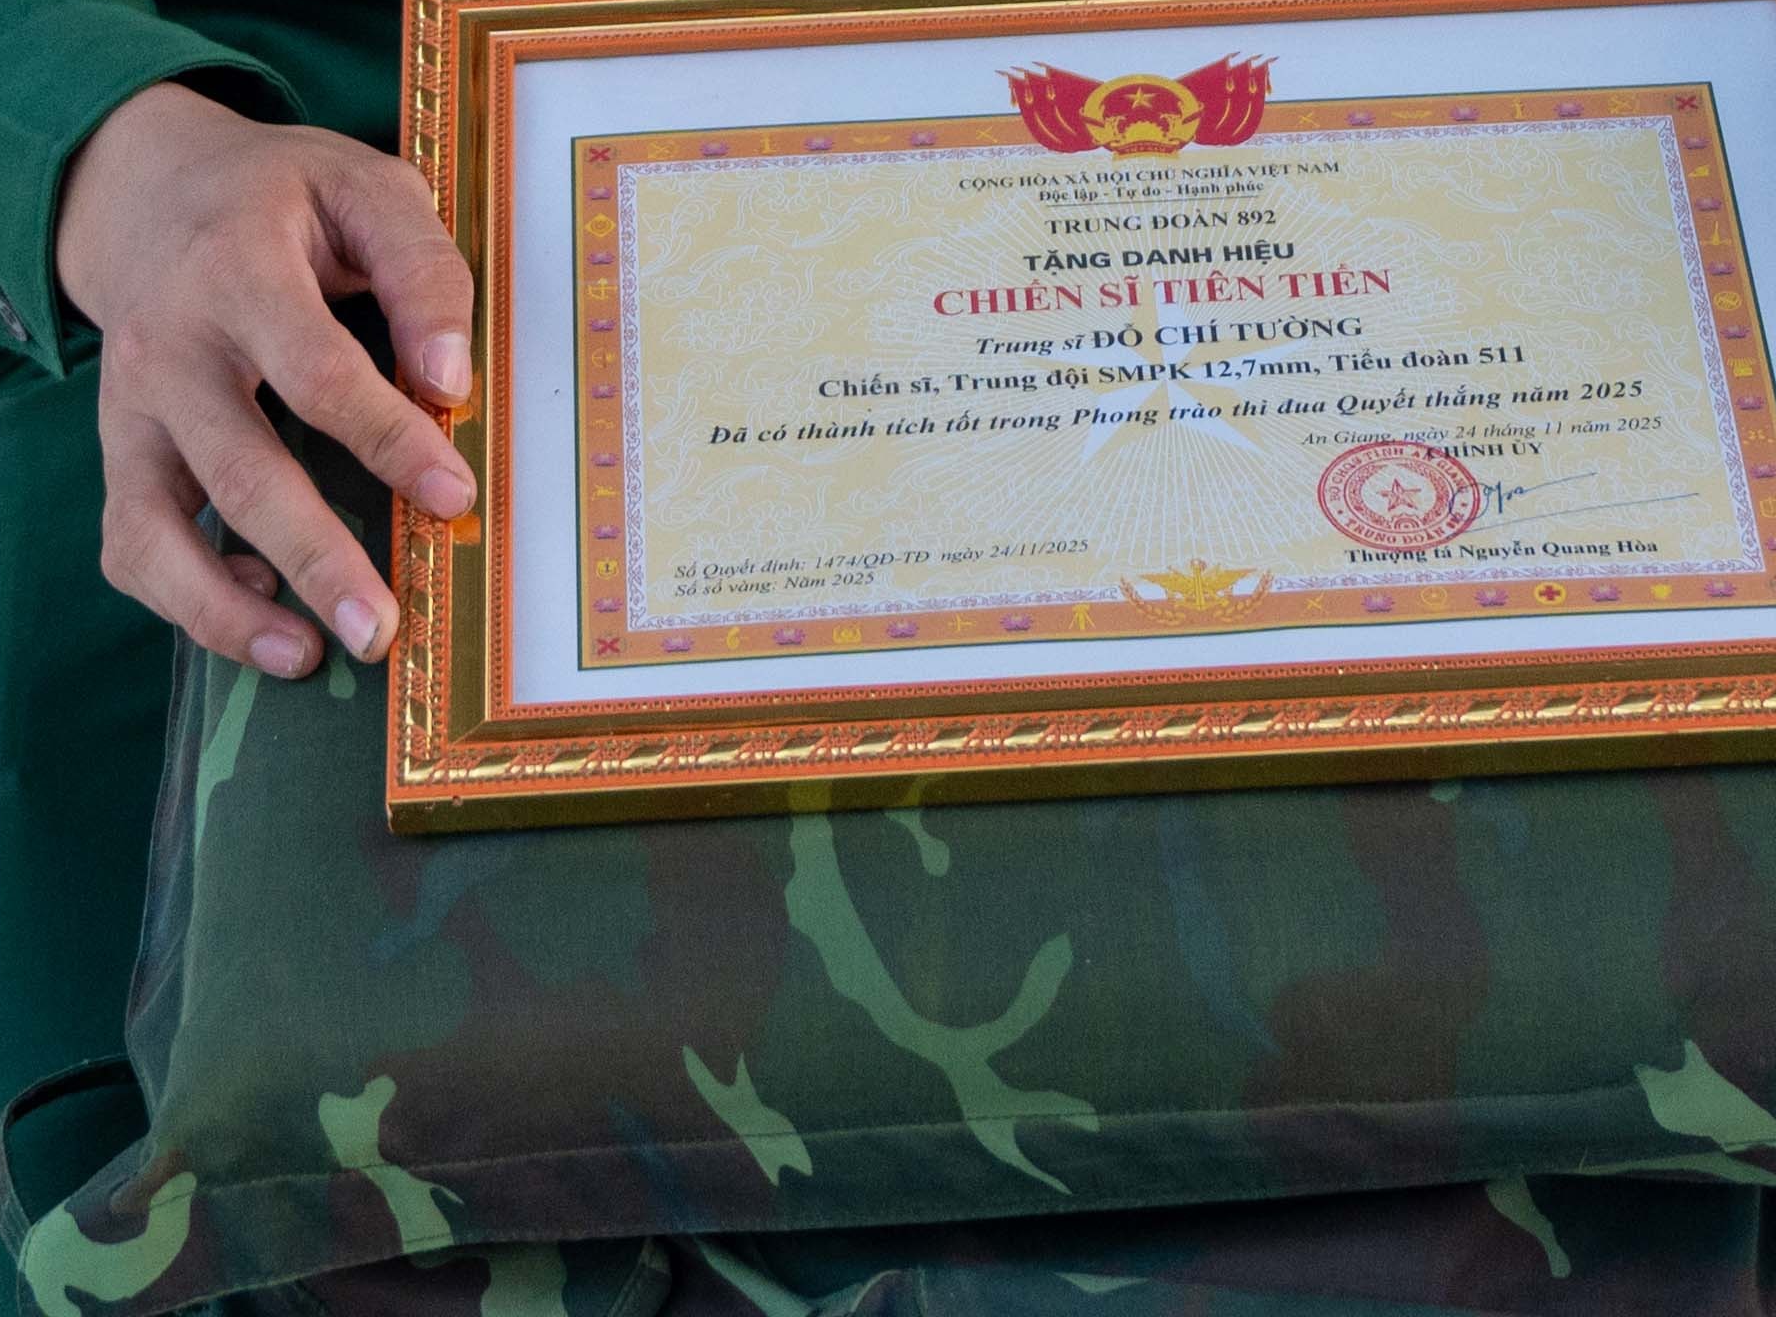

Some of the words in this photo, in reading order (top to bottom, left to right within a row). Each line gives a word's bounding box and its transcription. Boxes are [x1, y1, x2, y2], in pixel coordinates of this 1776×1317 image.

[959, 176, 1014, 192] CỘNG
[1020, 173, 1060, 188] HÒA
[1064, 169, 1091, 186] XÃ
[1096, 169, 1131, 187] HỘI
[1182, 162, 1242, 181] NGHĨA
[1247, 162, 1291, 178] VIỆT
[1297, 162, 1341, 174] NAM
[1040, 186, 1069, 203] Độc
[1073, 185, 1099, 203] lập
[1115, 185, 1137, 201] Tự
[1143, 184, 1162, 198] do
[1177, 182, 1220, 198] Hạnh
[1225, 180, 1265, 197] phúc
[1045, 215, 1141, 235] TRUNG
[1152, 210, 1229, 231] ĐOÀN
[1237, 209, 1277, 226] 892
[1023, 249, 1112, 278] TẶNG
[1123, 246, 1212, 266] DANH
[1223, 240, 1295, 265] HIỆU
[933, 278, 1083, 318] CHIẾN
[1099, 275, 1140, 308] SĨ
[1153, 270, 1266, 305] TIÊN
[1278, 262, 1392, 298] TIẾN
[976, 337, 1054, 357] Trung
[1062, 334, 1084, 352] sĩ
[1093, 322, 1143, 350] ĐỖ
[1155, 318, 1220, 346] CHÍ
[1230, 316, 1362, 343] TƯỜNG
[819, 373, 899, 398] Chiến
[911, 376, 940, 396] sĩ,
[948, 372, 1038, 395] Trung
[1046, 367, 1089, 388] đội
[1098, 363, 1192, 384] SMPK
[1201, 359, 1321, 380] 12,7mm,
[1328, 351, 1392, 373] Tiểu
[1401, 348, 1470, 369] đoàn
[1478, 346, 1524, 364] 511
[709, 424, 747, 445] Đã
[757, 422, 787, 442] có
[796, 419, 876, 441] thành
[885, 415, 936, 435] tích
[946, 410, 982, 433] tốt
[989, 413, 1061, 432] trong
[1073, 406, 1159, 426] Phong
[1169, 401, 1223, 421] trào
[1232, 398, 1268, 418] thi
[1277, 395, 1327, 415] đua
[1336, 387, 1416, 416] Quyết
[1425, 385, 1501, 411] thắng
[1511, 383, 1570, 403] năm
[1580, 380, 1644, 401] 2025
[1302, 431, 1327, 446] An
[1404, 426, 1449, 444] ngày
[1454, 425, 1476, 439] 24
[1483, 423, 1537, 440] tháng
[1544, 421, 1562, 435] 11
[1570, 418, 1611, 433] năm
[1617, 416, 1663, 431] 2025
[702, 560, 755, 581] Quyết
[760, 559, 805, 576] định:
[940, 547, 984, 564] ngày
[989, 539, 1090, 560] 24/11/2025
[1345, 546, 1426, 564] Thượng
[1434, 546, 1452, 560] tá
[1459, 539, 1536, 561] Nguyễn
[1542, 541, 1613, 559] Quang
[1618, 540, 1659, 555] Hòa
[729, 578, 776, 596] vàng:
[784, 572, 826, 589] Năm
[831, 571, 875, 586] 2025
